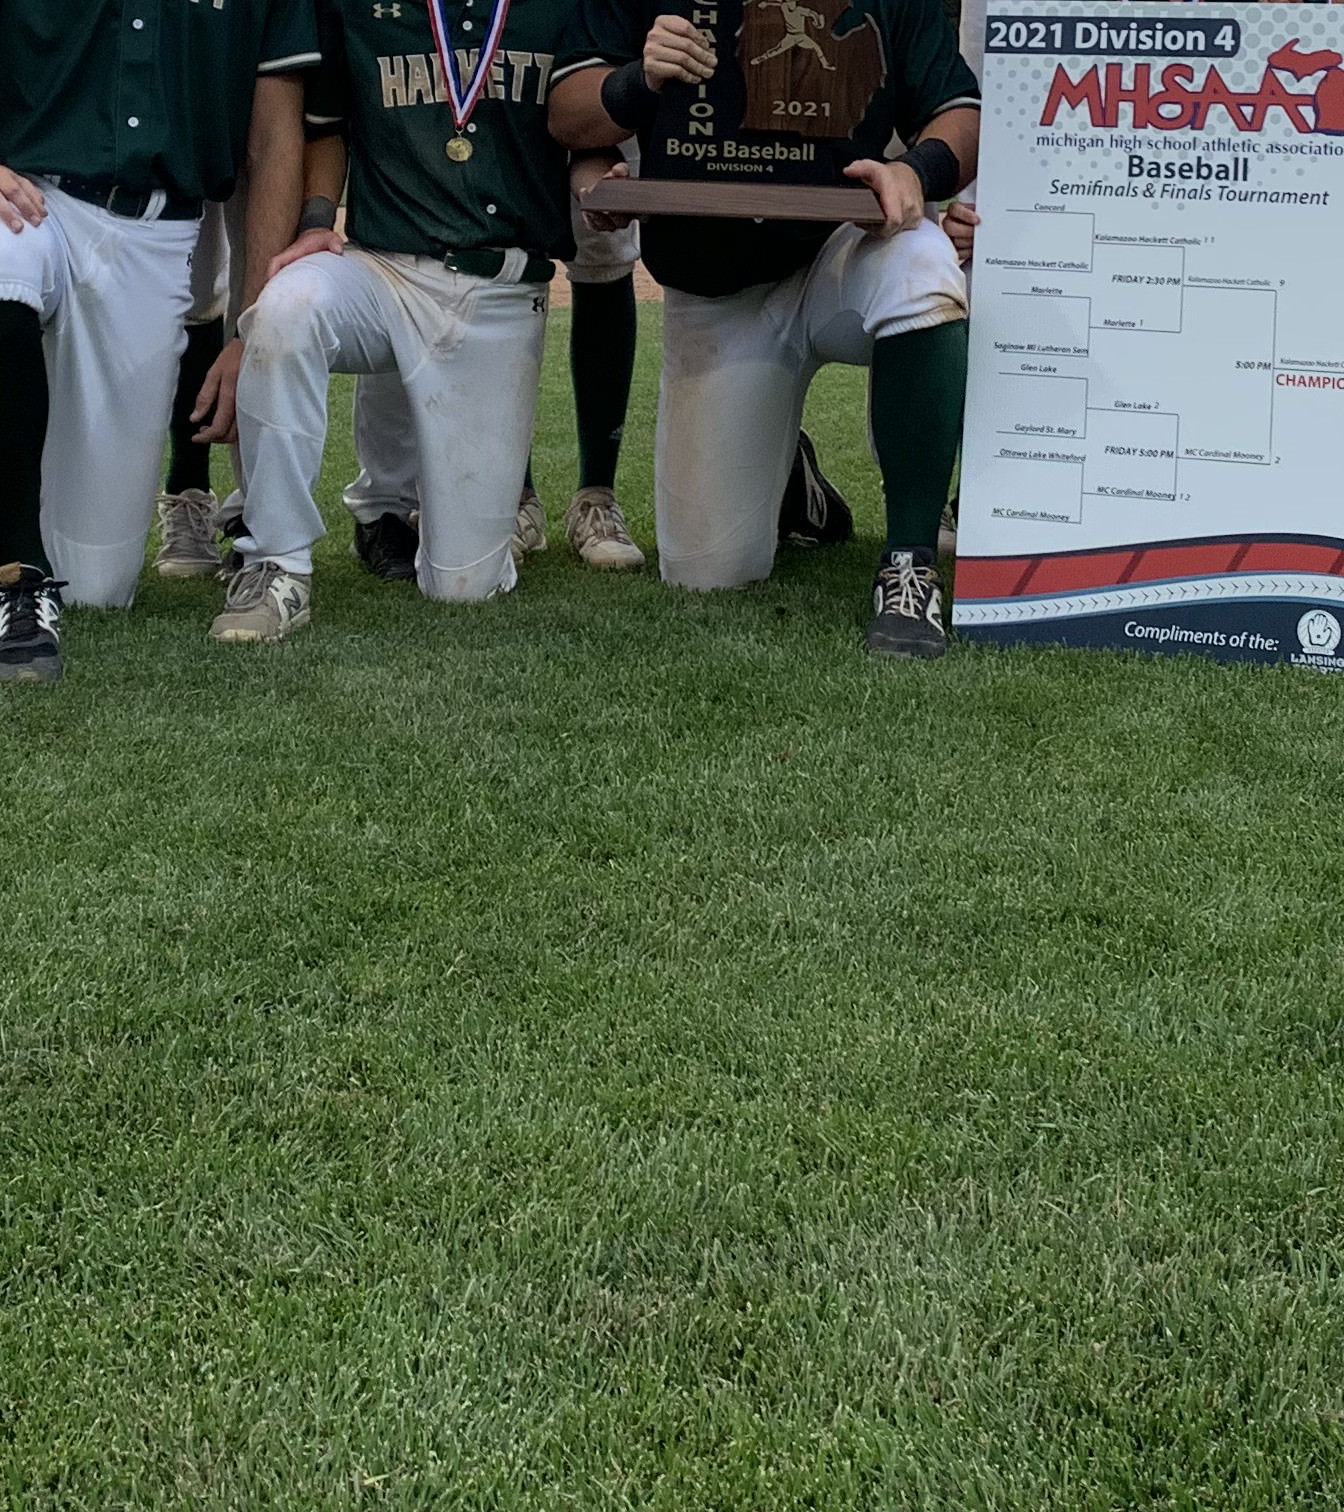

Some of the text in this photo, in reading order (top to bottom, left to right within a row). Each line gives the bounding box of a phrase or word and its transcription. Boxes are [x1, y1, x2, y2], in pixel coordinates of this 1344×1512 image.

[988, 21, 1235, 52] 2021 Division 4
[1039, 63, 1316, 134] MHSAA
[772, 100, 831, 117] 2021
[666, 138, 815, 162] Boys Baseball
[1036, 133, 1104, 150] michigan
[1109, 135, 1142, 153] high
[1146, 137, 1197, 152] school
[1201, 138, 1260, 154] athletic
[707, 162, 774, 173] DIVISION 4
[1127, 155, 1249, 182] Baseball
[1049, 179, 1330, 206] Semifinals & Finals Tournament
[1034, 203, 1066, 212] Concord
[1095, 234, 1137, 243] Kalamazoo
[1139, 236, 1168, 244] Hackett
[1169, 236, 1201, 245] Catholic
[985, 258, 1089, 269] Kalamazoo Hackett Catholic
[1111, 274, 1181, 286] FRIDAY 2:30 PM
[1103, 319, 1136, 328] Marlette
[994, 342, 1025, 353] Saginaw
[1037, 344, 1071, 353] Lutheran
[1021, 364, 1057, 374] Glen Lake
[1235, 361, 1271, 370] 5:00 PM
[1114, 400, 1131, 409] Glen
[1133, 401, 1152, 410] Lake
[1014, 424, 1045, 435] Gaylord
[1057, 426, 1076, 436] Mary
[999, 448, 1086, 462] Ottawa Lake Whiteford
[1104, 445, 1174, 458] FRIDAY 5:00 PM
[1184, 448, 1281, 464] MC Cardinal Mooney 2
[1097, 486, 1112, 494] MC
[1112, 487, 1143, 497] Cardinal
[1145, 490, 1176, 501] Mooney
[993, 508, 1070, 522] MC Cardinal Mooney
[1124, 620, 1280, 652] Compliments of the:
